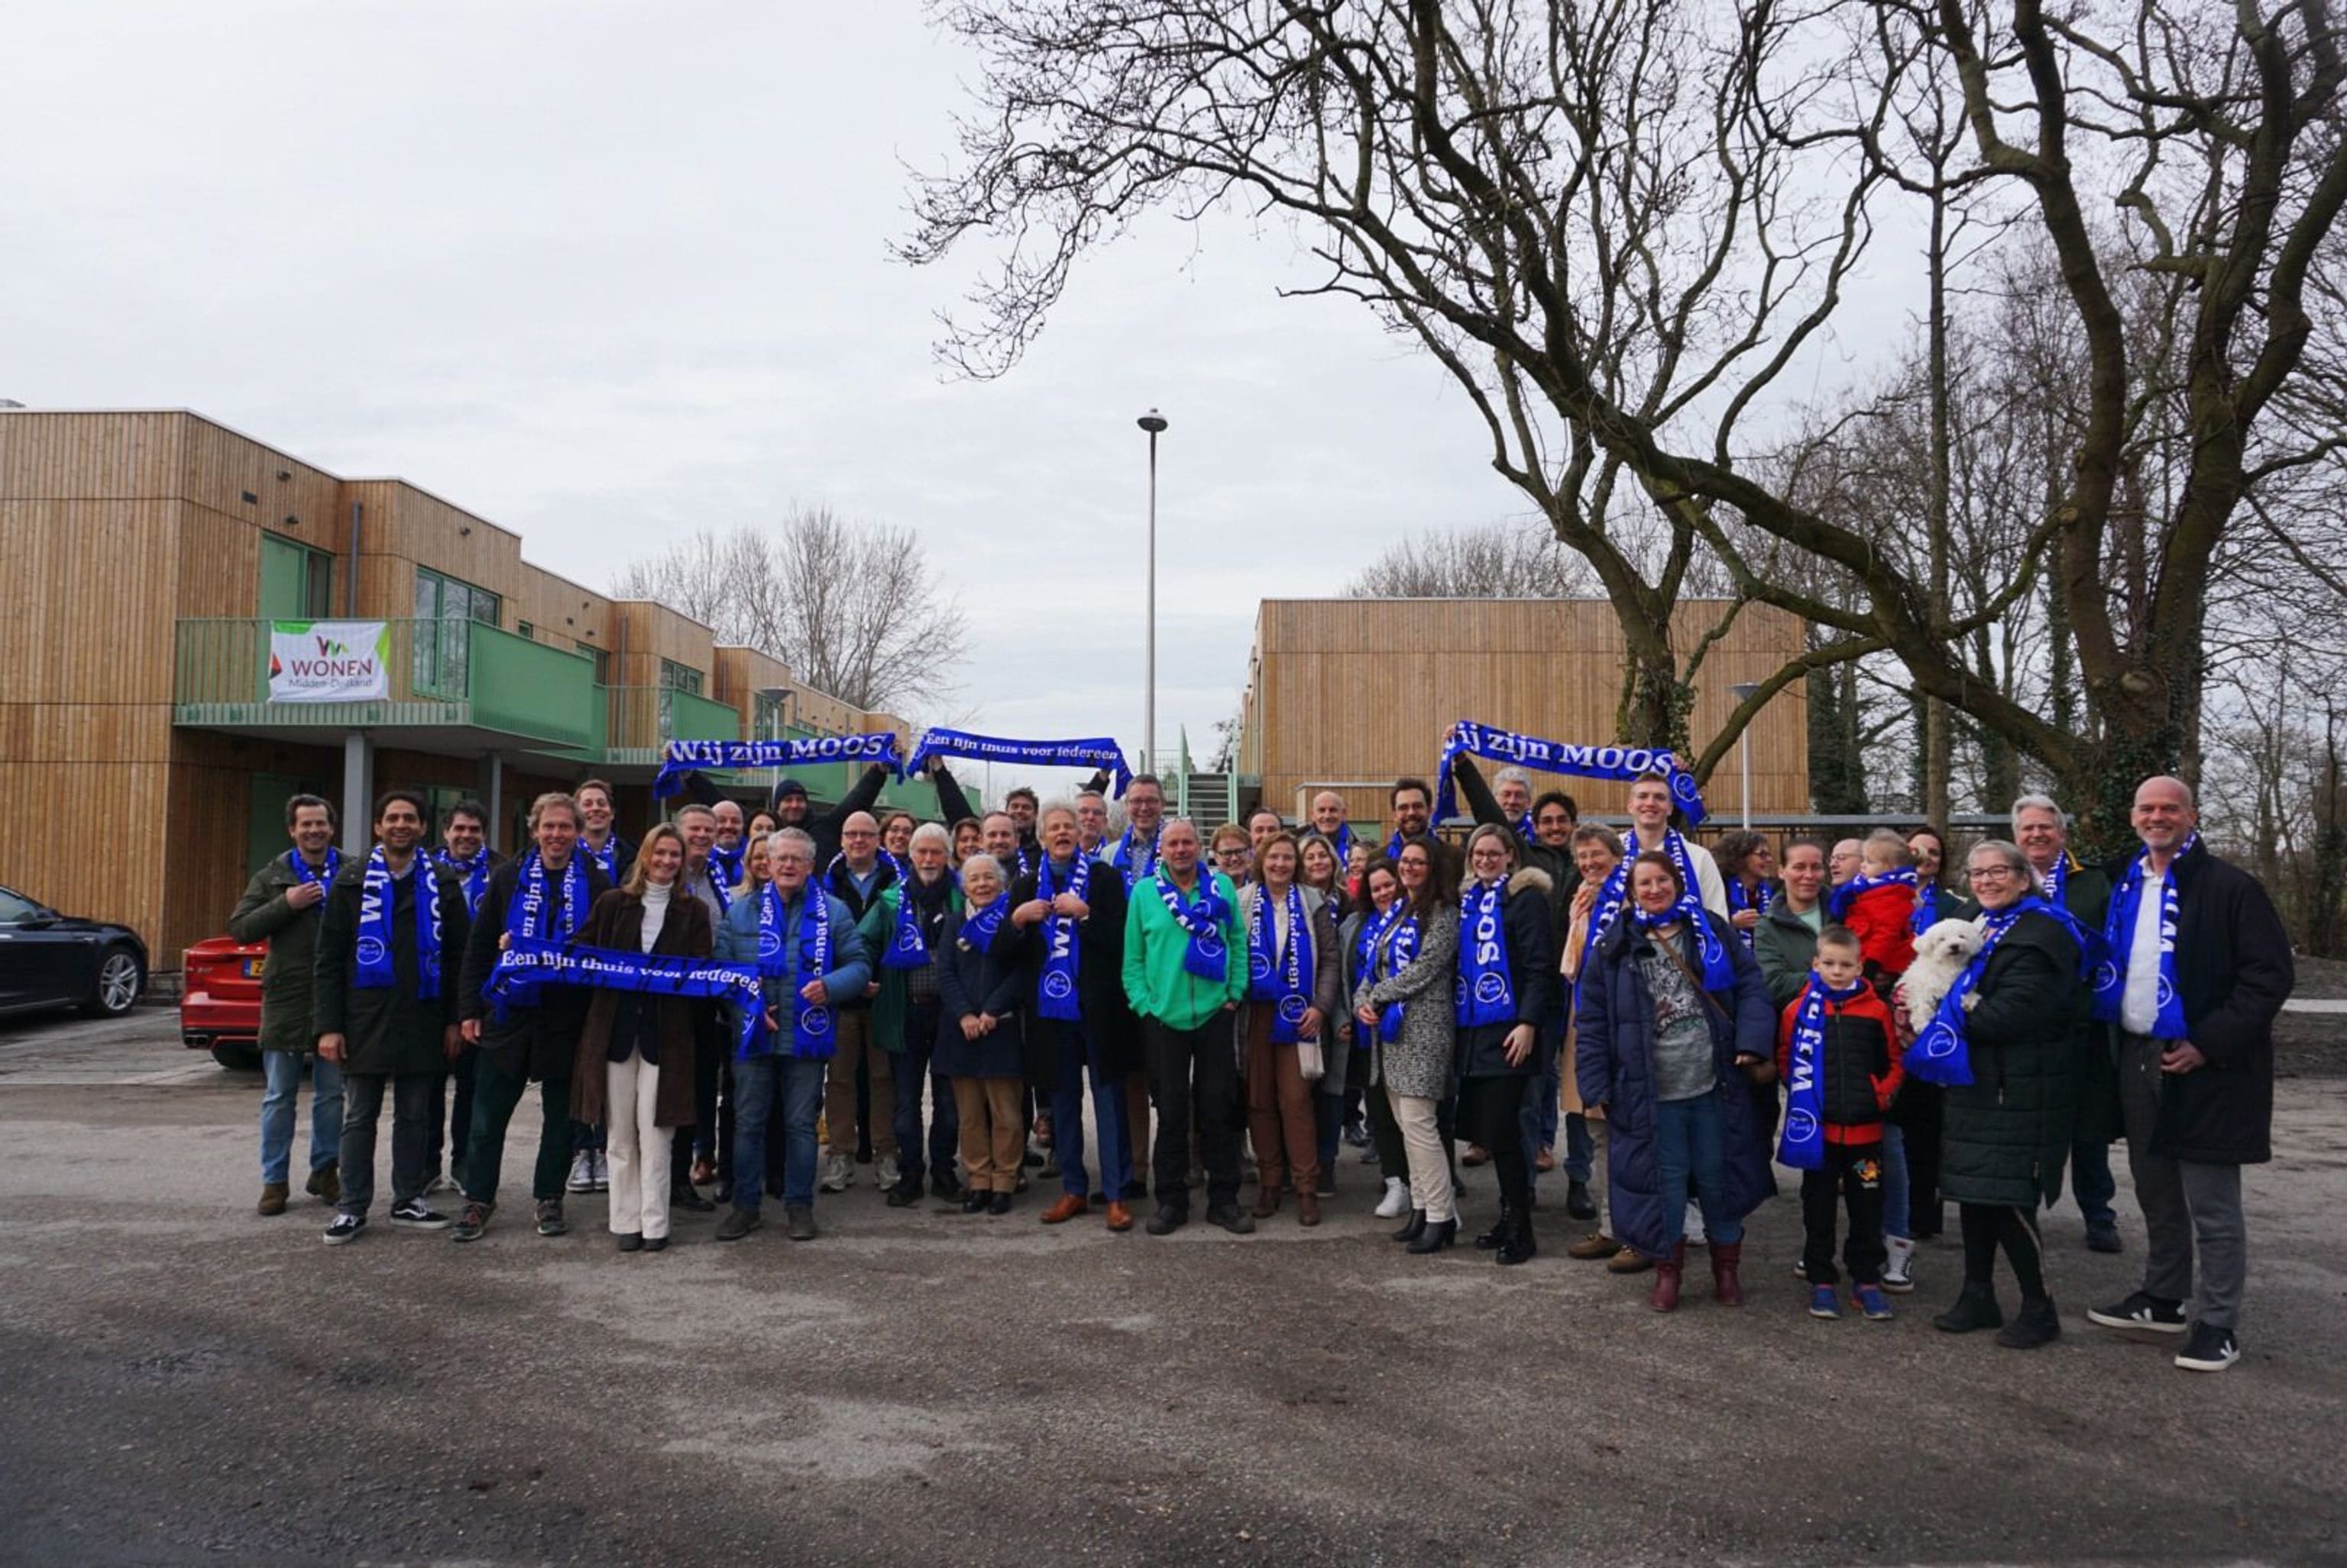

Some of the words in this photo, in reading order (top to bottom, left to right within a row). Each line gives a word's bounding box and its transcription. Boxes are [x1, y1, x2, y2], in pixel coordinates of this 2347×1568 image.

[291, 658, 372, 677] WONEN
[671, 740, 723, 765] Wij
[730, 741, 783, 765] zijn
[790, 735, 887, 758] MOOS
[925, 733, 950, 745] Een
[1021, 746, 1054, 756] voor
[1488, 732, 1550, 761] zijn
[1559, 745, 1675, 778] MOOS
[1050, 917, 1072, 962] Wi
[500, 950, 538, 967] Een
[542, 951, 575, 970] fijn
[581, 957, 634, 974] thuis
